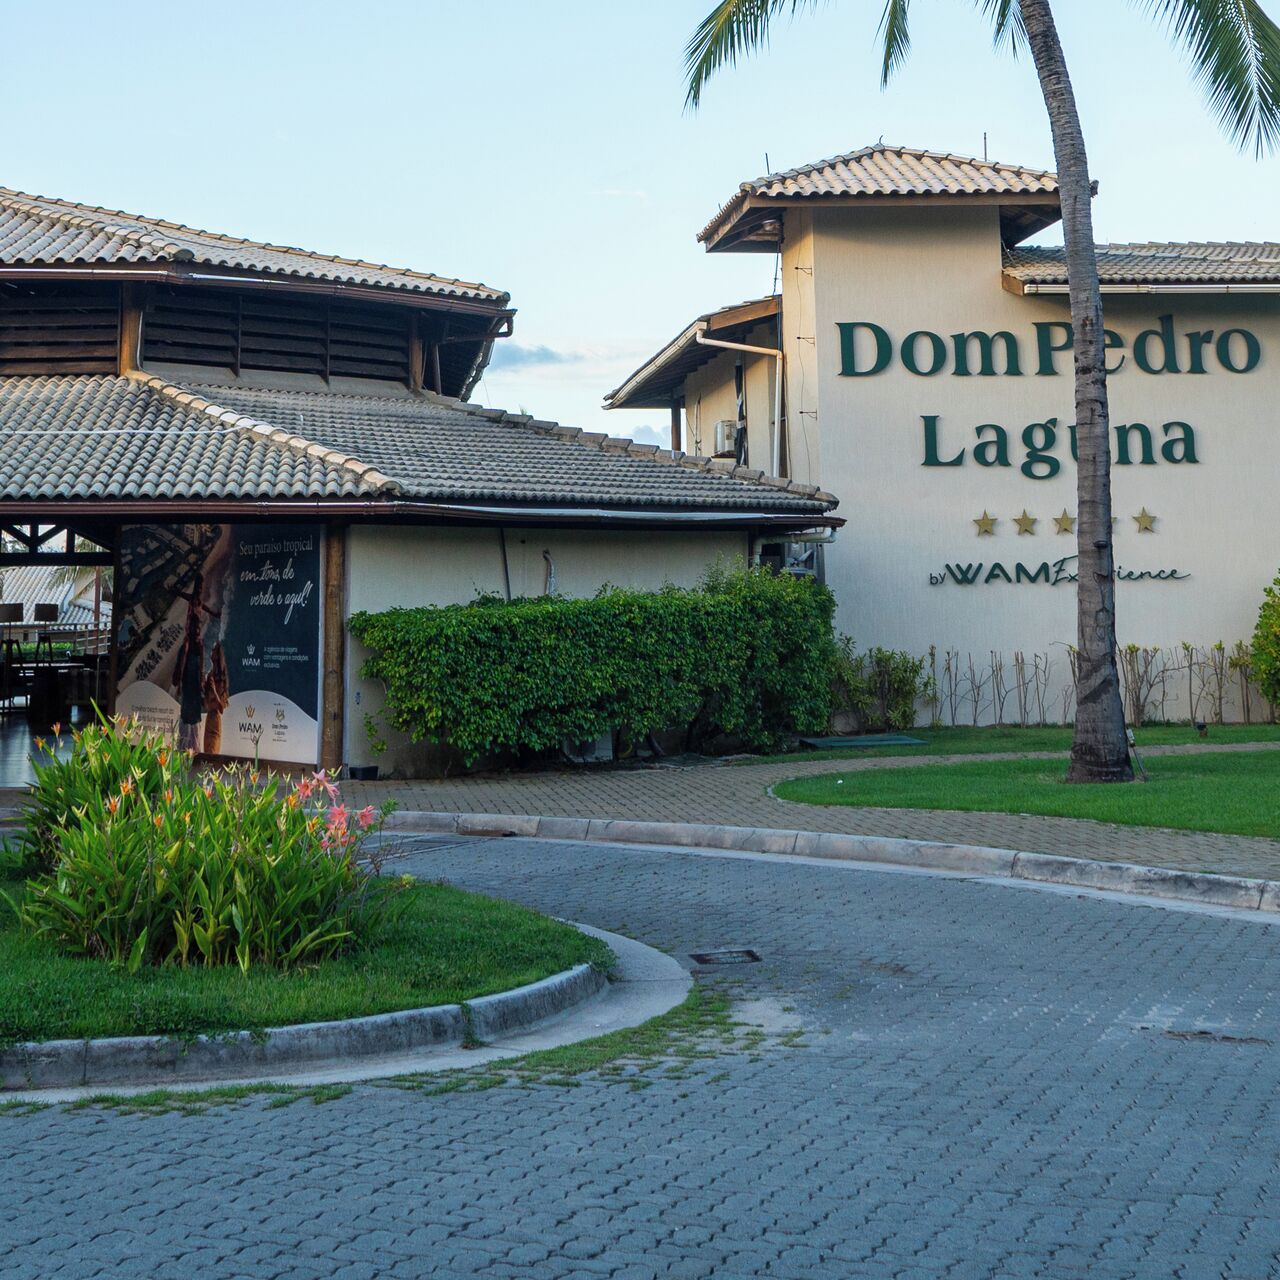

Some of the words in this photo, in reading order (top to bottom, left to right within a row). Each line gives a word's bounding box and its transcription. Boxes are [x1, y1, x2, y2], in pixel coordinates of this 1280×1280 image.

[835, 321, 1024, 377] Dom
[239, 540, 253, 556] Seu
[283, 534, 313, 557] tropical
[282, 557, 295, 580] de
[929, 571, 947, 586] by
[945, 562, 1050, 585] WAM
[249, 583, 275, 606] verde
[276, 593, 284, 606] e
[242, 657, 261, 667] WAM
[238, 721, 262, 733] WAM
